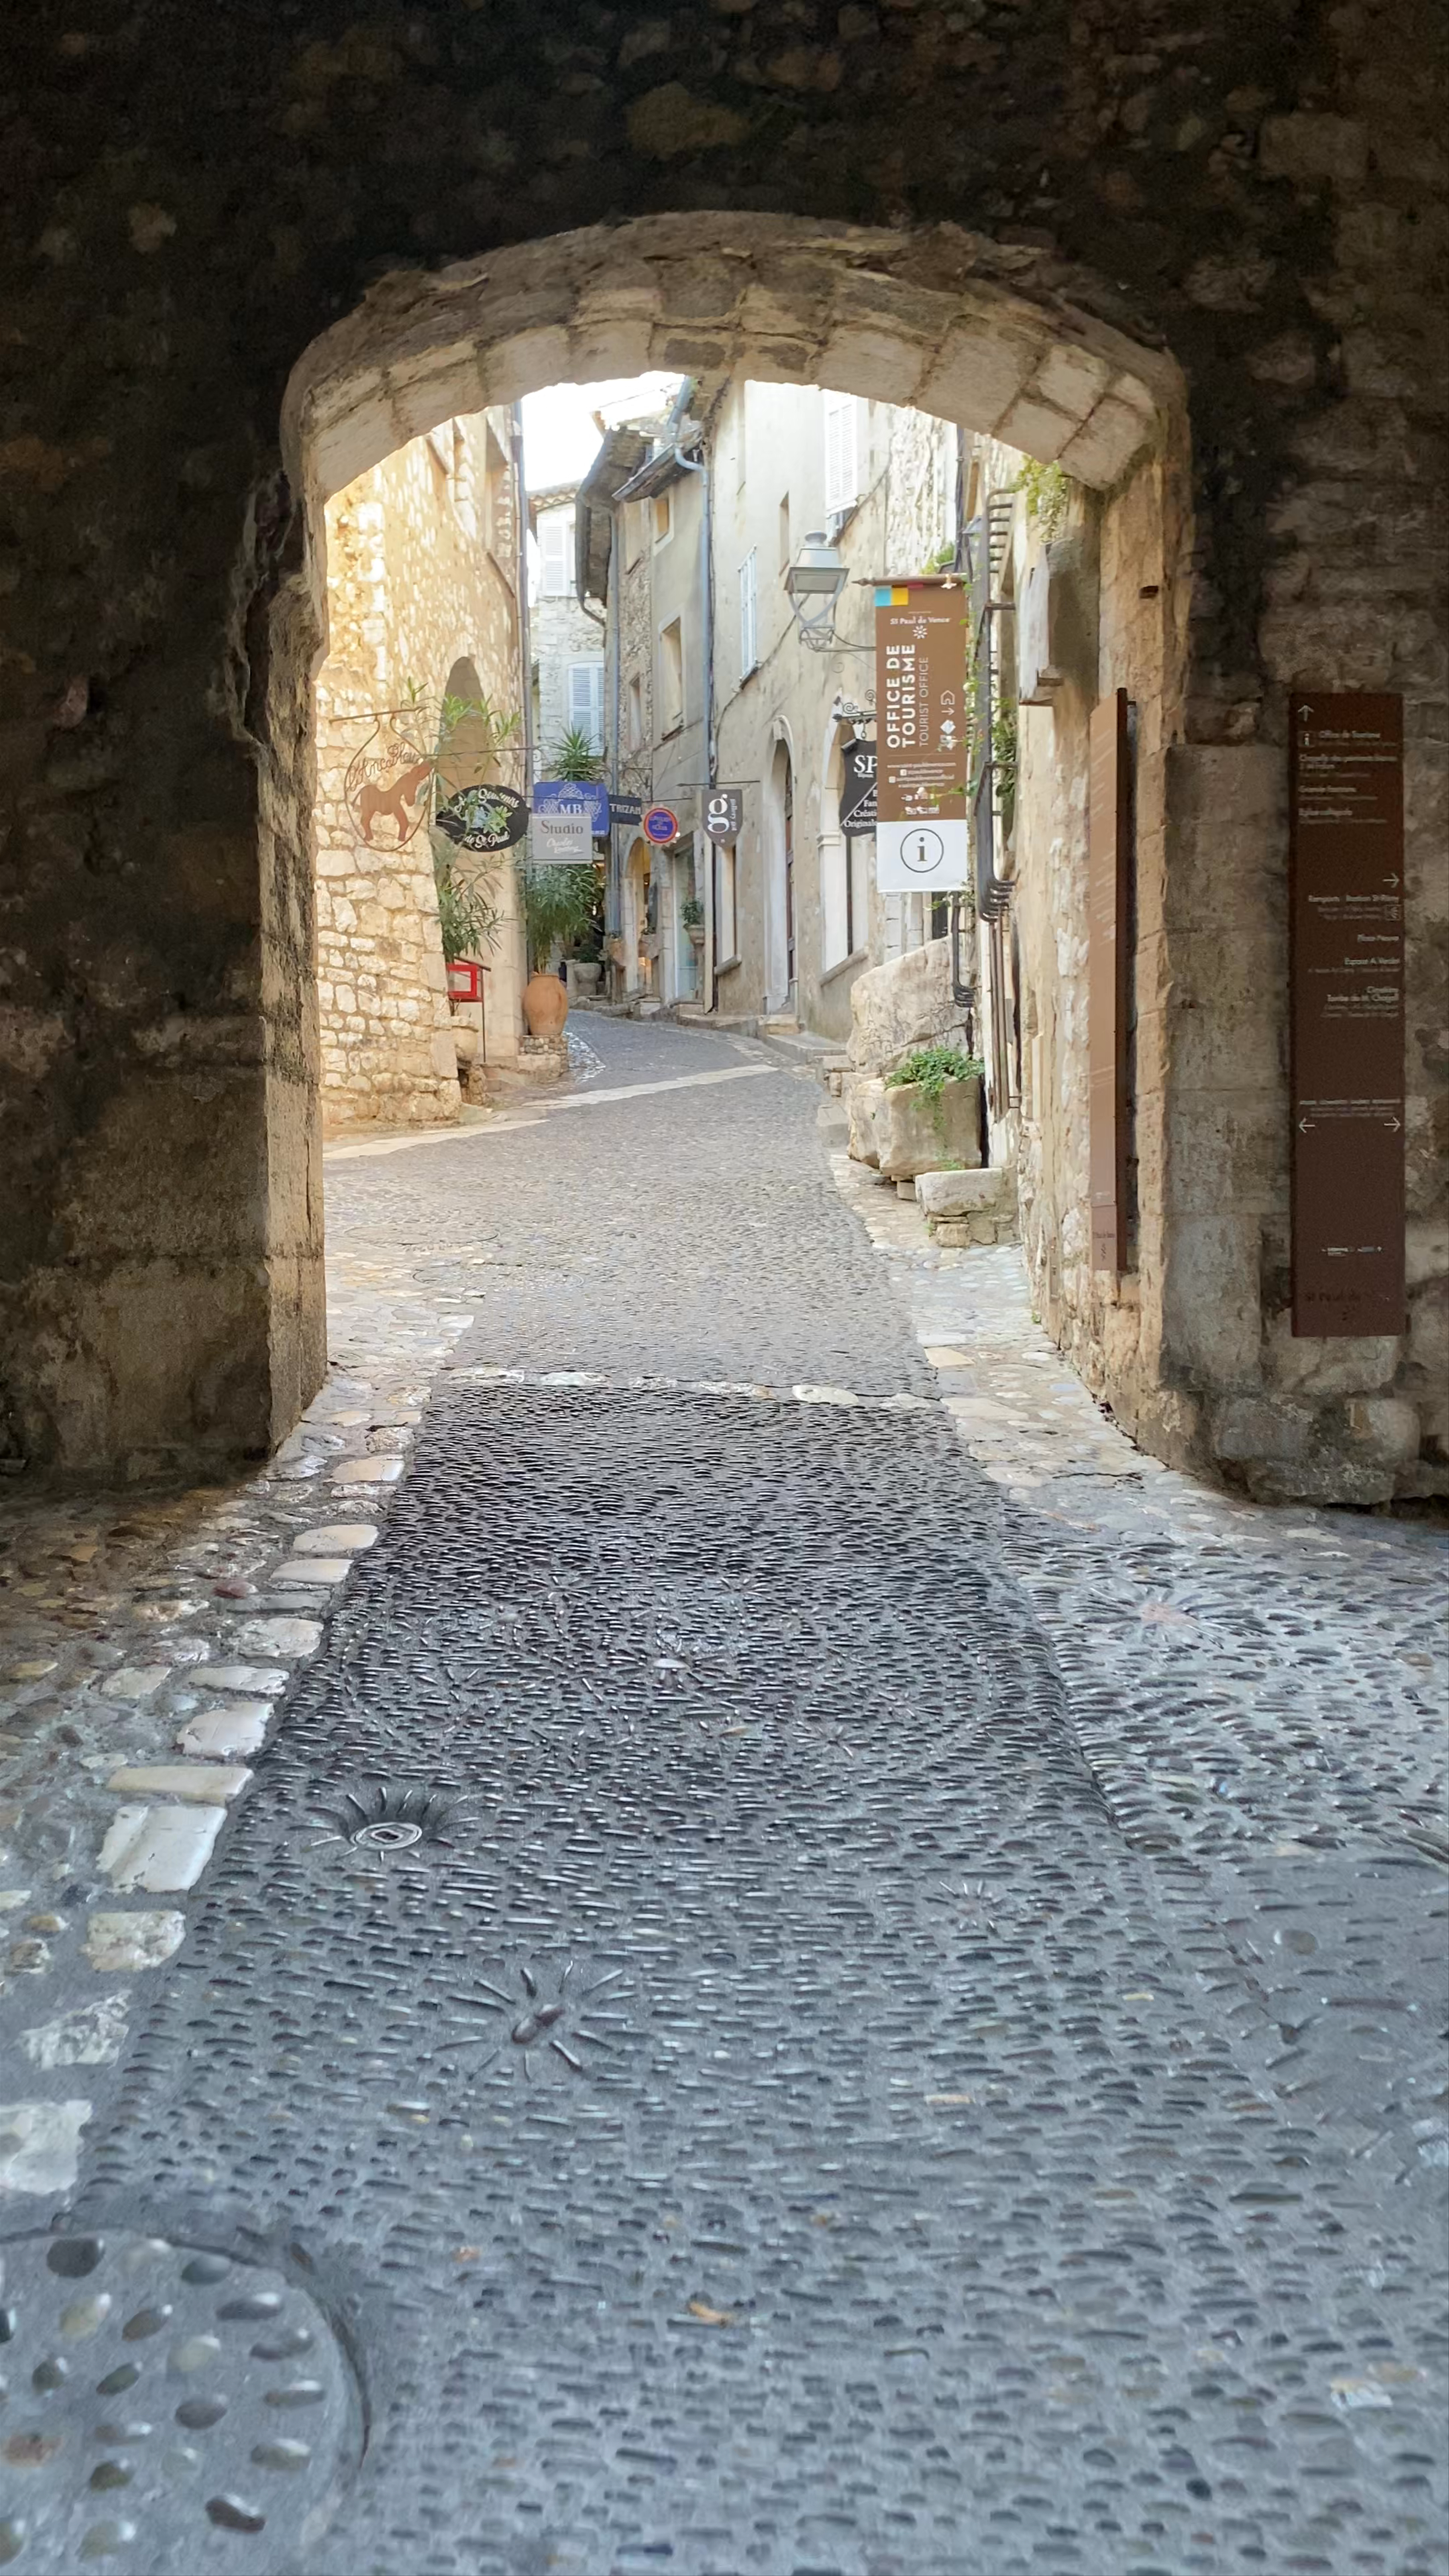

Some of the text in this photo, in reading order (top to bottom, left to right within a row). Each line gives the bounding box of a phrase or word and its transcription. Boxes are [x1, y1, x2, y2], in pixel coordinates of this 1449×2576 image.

[900, 616, 916, 624] Paul
[886, 645, 900, 748] OFFICE DE
[901, 644, 915, 748] TOURISME
[919, 657, 929, 747] TOURIST OFFICE
[540, 820, 584, 834] Studio
